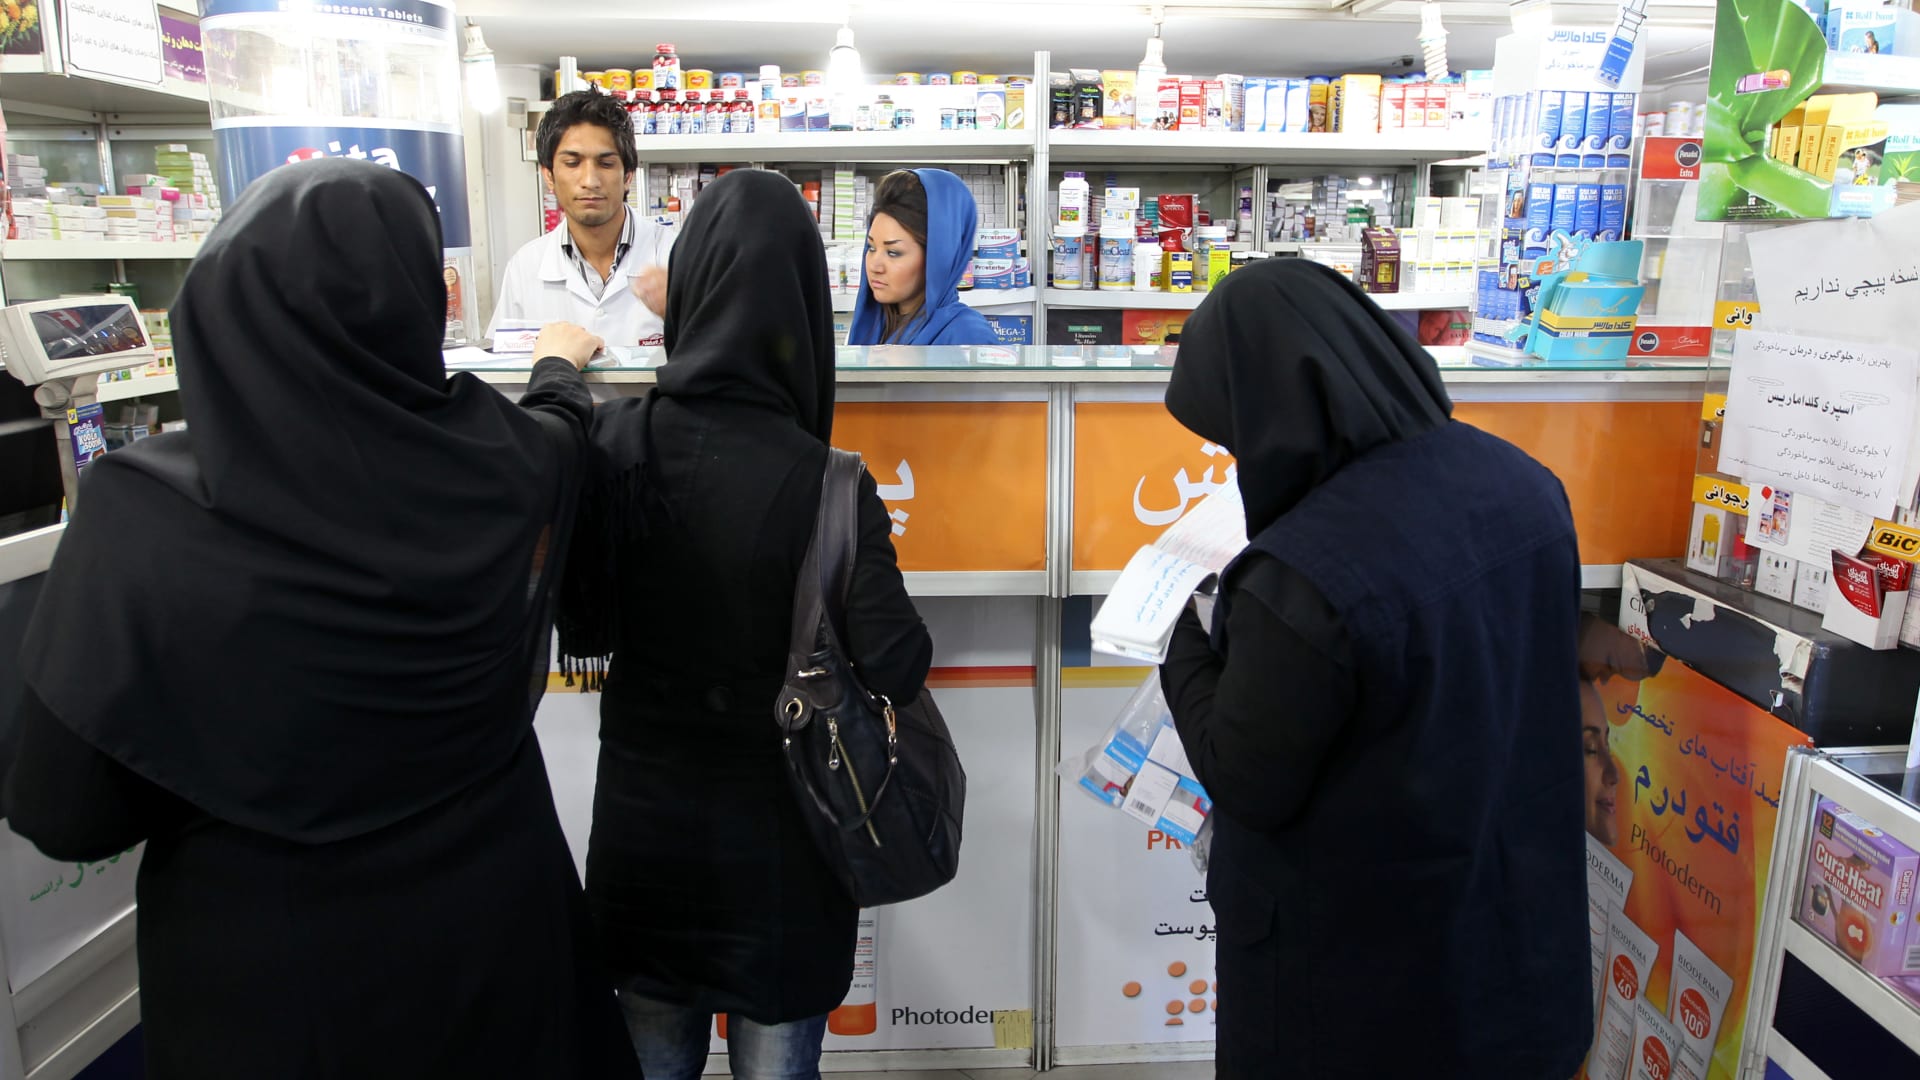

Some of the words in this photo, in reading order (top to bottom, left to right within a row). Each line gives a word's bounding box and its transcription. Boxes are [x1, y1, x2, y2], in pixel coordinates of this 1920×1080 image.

[378, 7, 423, 24] Tablets
[1680, 169, 1693, 177] Extra
[1890, 265, 1919, 284] نسخه
[1794, 277, 1840, 305] نداریم
[1726, 307, 1753, 325] وانی
[993, 328, 1026, 337] MEGA-3
[1752, 340, 1788, 353] سرماخوردگی
[1789, 344, 1813, 359] درمان
[1819, 349, 1854, 363] جلوگیری
[1857, 353, 1867, 366] راه
[1868, 358, 1892, 369] بهترین
[1821, 401, 1855, 422] اسپری
[1781, 427, 1820, 444] سرماخوردگی
[1849, 445, 1879, 457] جلوگیری
[1793, 468, 1811, 480] داخل
[1858, 468, 1878, 480] بهبود
[1831, 480, 1849, 491] سازی
[1849, 486, 1870, 499] مرطوب
[1617, 702, 1675, 736] تخصصی
[1679, 734, 1707, 759] های
[1711, 757, 1757, 791] آفتاب
[1823, 813, 1833, 828] 12
[1586, 849, 1624, 885] ODERMA
[1630, 823, 1721, 916] Photoderm
[1815, 843, 1882, 907] Cura-Heat
[1824, 870, 1849, 898] PERIOD
[1850, 888, 1869, 909] PAIN
[1611, 923, 1647, 964] BIODERMA
[1678, 954, 1720, 1000] BIODERMA
[1618, 978, 1632, 1000] 40
[892, 1005, 1018, 1026] Photoder
[1684, 1008, 1704, 1039] 100
[1637, 1003, 1677, 1050] BIODERMA
